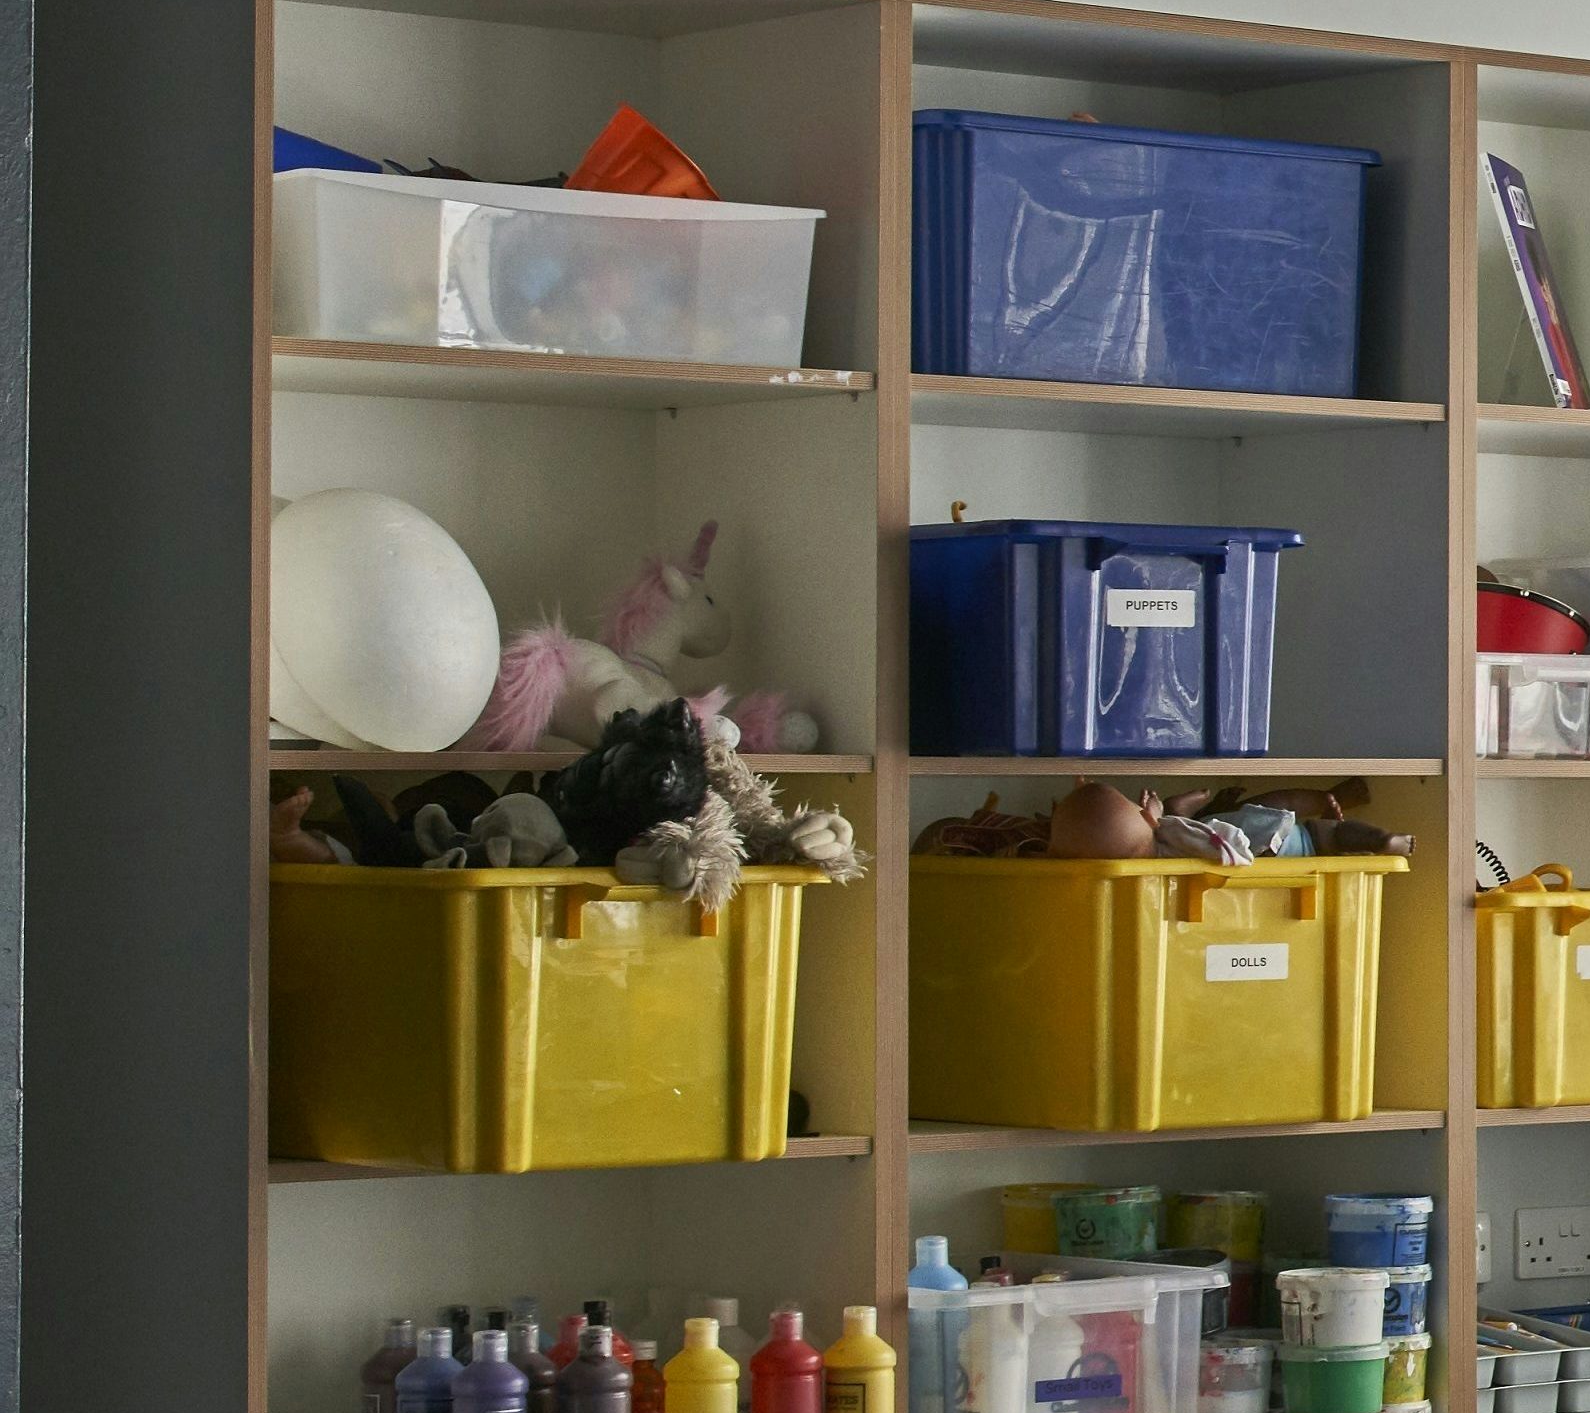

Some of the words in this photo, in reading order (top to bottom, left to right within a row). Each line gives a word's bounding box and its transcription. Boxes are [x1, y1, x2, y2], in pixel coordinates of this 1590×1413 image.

[1126, 600, 1178, 611] PUPPETS
[1231, 957, 1267, 968] DOLLS
[1045, 1380, 1080, 1395] Small
[1083, 1377, 1114, 1392] Toys
